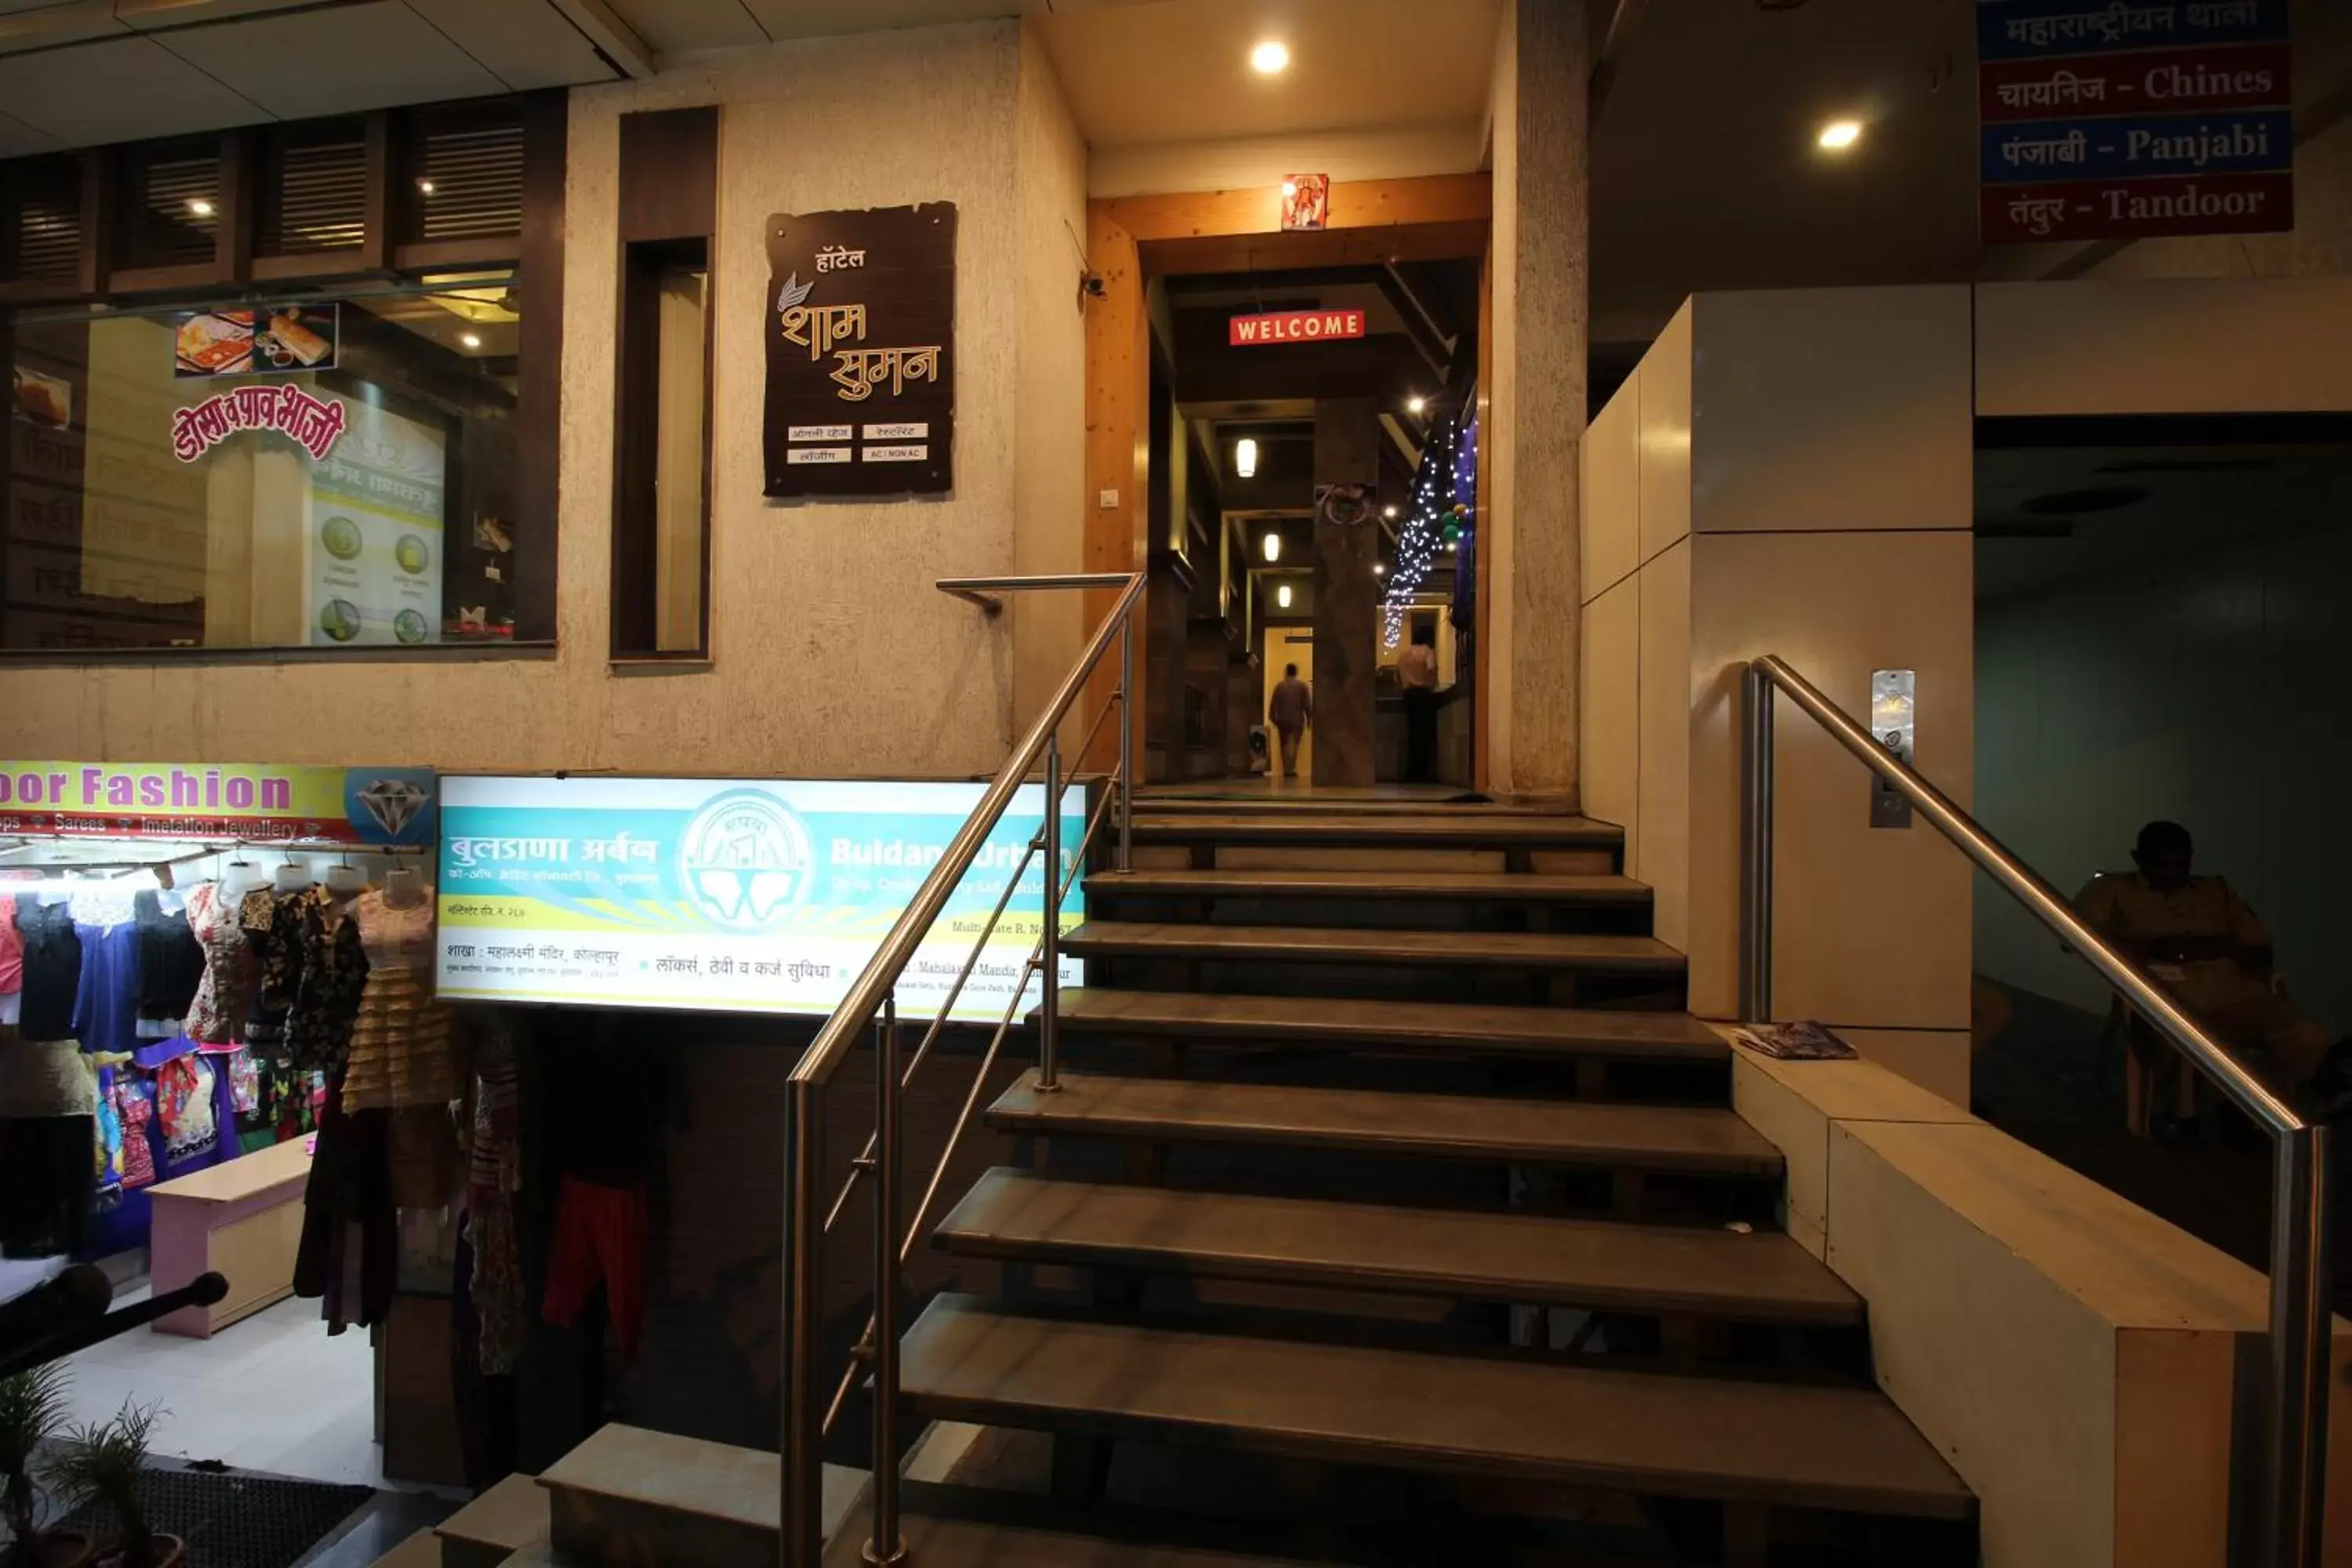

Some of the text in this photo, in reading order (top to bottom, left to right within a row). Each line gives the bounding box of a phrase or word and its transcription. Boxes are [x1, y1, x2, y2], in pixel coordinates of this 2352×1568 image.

[2143, 63, 2274, 100] Chines
[2000, 128, 2089, 168] पंजाबी
[2125, 122, 2270, 167] Panjabi
[2100, 183, 2267, 220] Tandoor
[815, 245, 866, 274] हॉटेल
[781, 303, 867, 361] शाम
[1237, 314, 1359, 340] WELCOME
[828, 345, 942, 401] सुमन
[172, 397, 227, 463] डोसा
[234, 385, 281, 430] पाव
[277, 383, 346, 461] भाजी
[81, 766, 292, 811] Fashion
[54, 813, 106, 832] Sarees
[219, 818, 298, 839] Jewellery
[448, 831, 661, 867] बुलडाणा अर्बन
[831, 838, 944, 867] Buldan
[1014, 922, 1026, 934] R.
